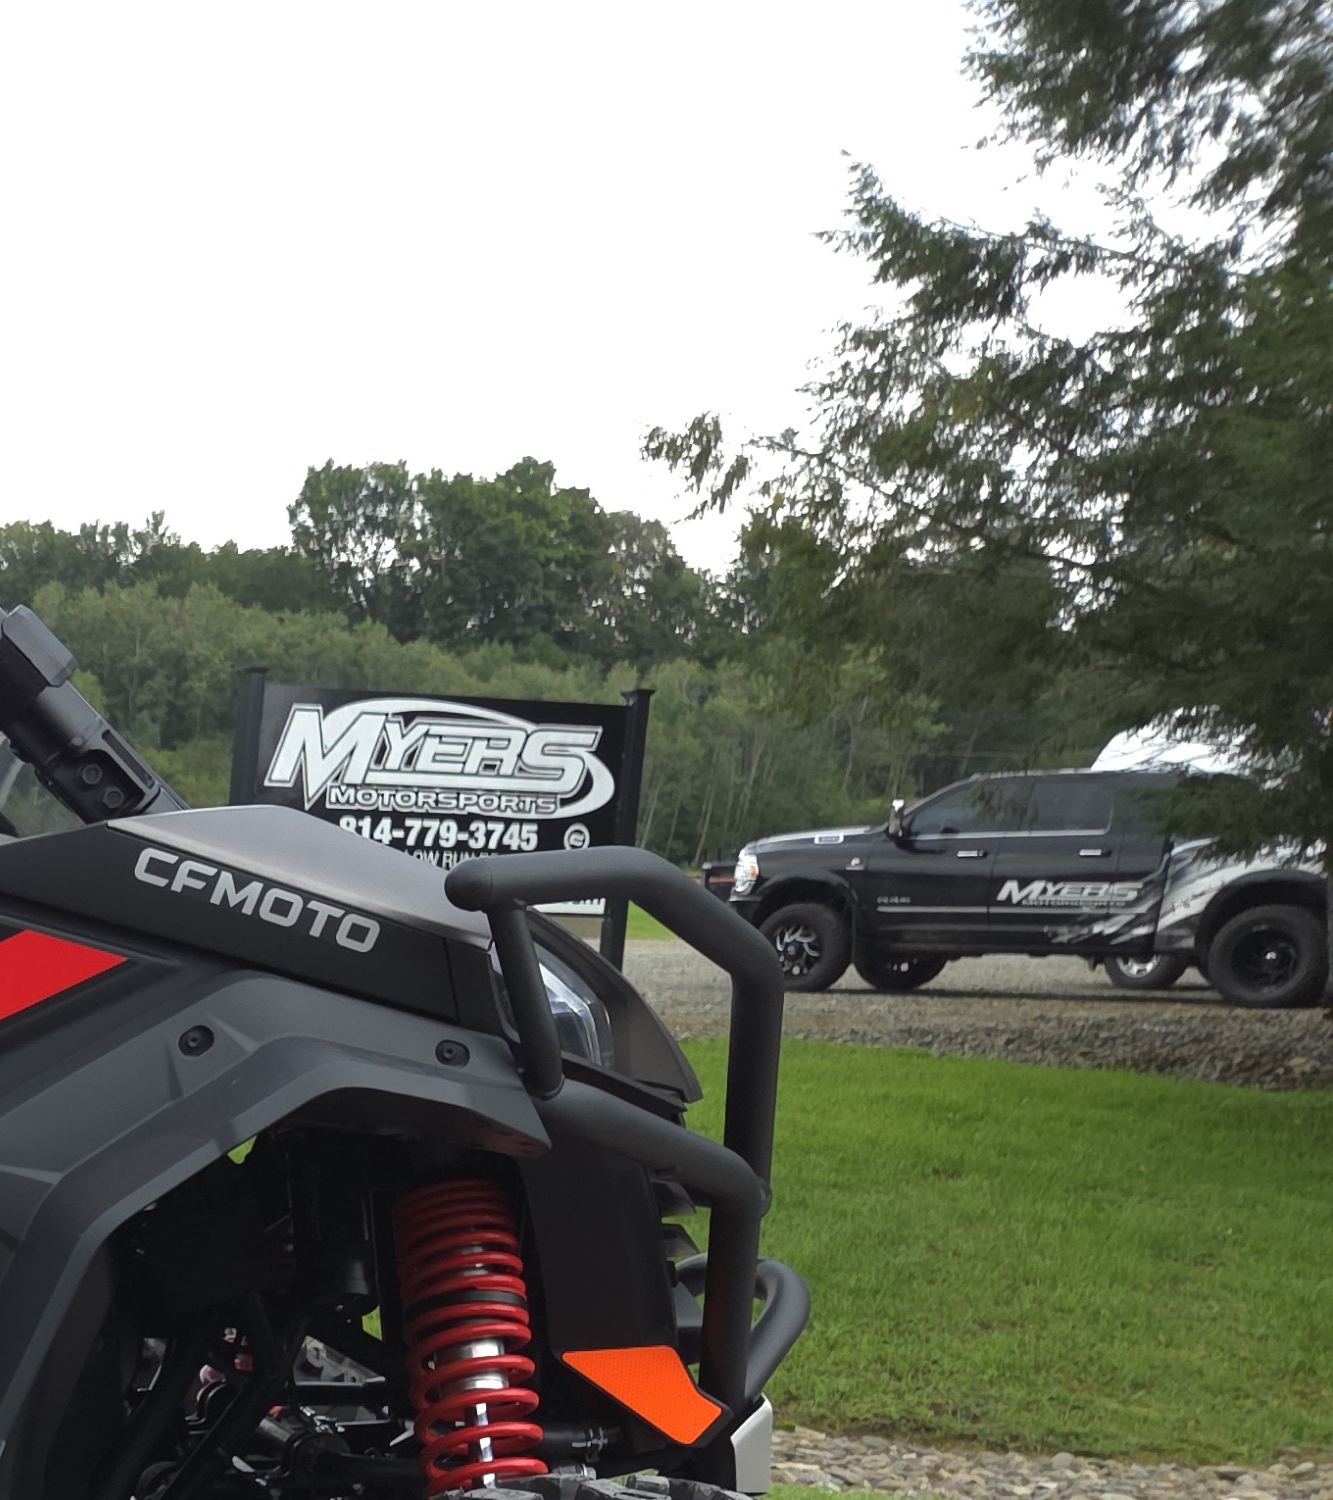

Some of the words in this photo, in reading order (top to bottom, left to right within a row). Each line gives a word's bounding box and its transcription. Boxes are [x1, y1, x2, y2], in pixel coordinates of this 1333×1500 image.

[265, 704, 602, 810] MYERS
[328, 785, 559, 815] MOTORSPORTS
[134, 847, 381, 953] CFMOTO
[996, 879, 1144, 904] MYERS
